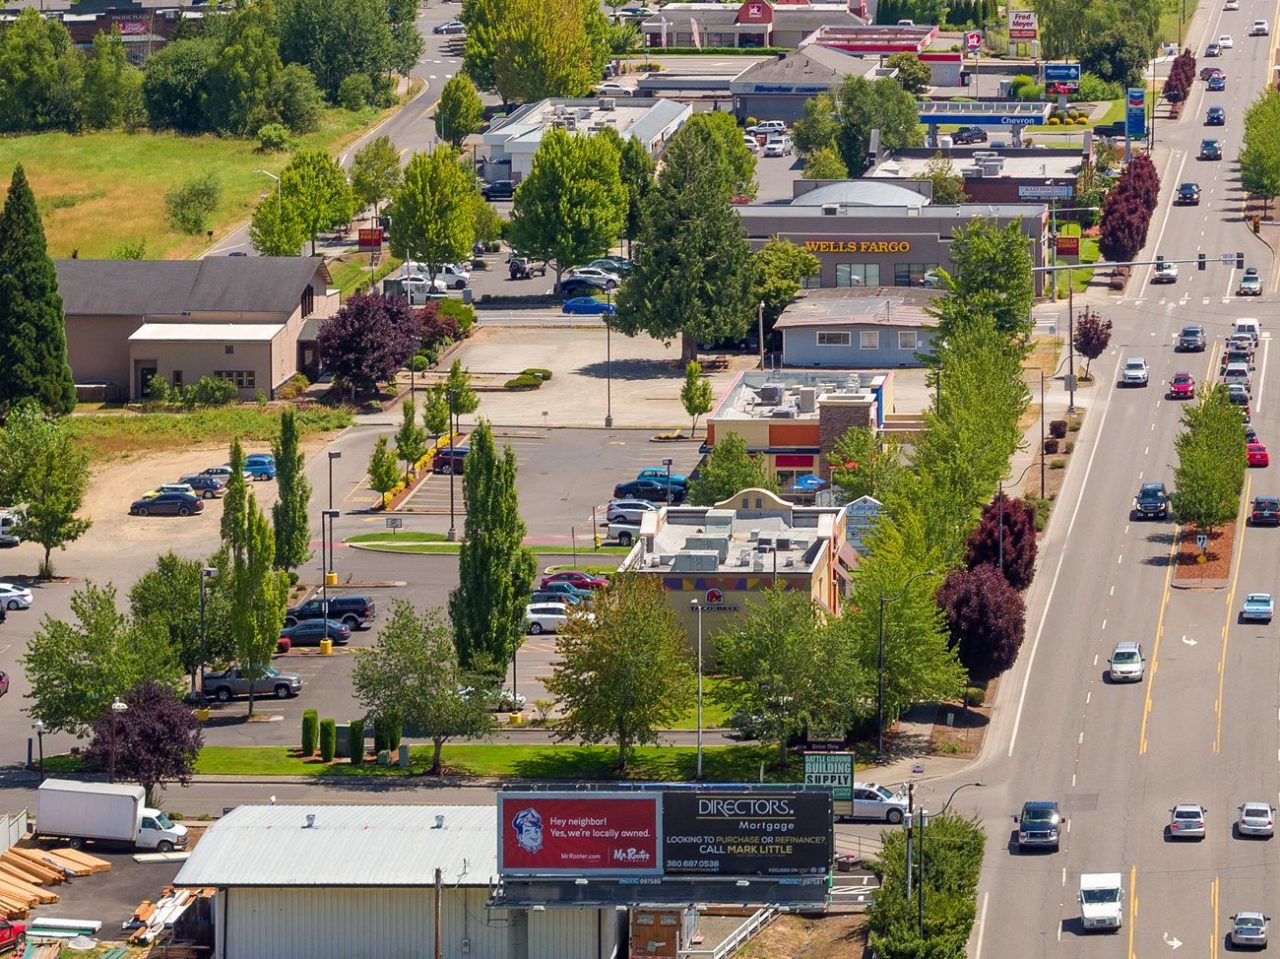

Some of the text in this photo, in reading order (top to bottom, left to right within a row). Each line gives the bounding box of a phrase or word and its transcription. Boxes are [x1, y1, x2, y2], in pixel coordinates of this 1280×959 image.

[1001, 116, 1034, 124] Chevron
[806, 241, 910, 253] WELLS FARGO
[805, 762, 851, 774] BUILDING
[807, 775, 849, 784] SUPPLY
[550, 817, 607, 827] Hey neighbor!
[739, 821, 795, 831] Mortgage
[551, 829, 650, 839] Yes, we're locally owned.
[666, 836, 825, 844] LOOKING TO PURCHASE OR REFINANCE?
[700, 845, 792, 854] CALL MARK LITTLE
[561, 852, 600, 860] MrRooter.com
